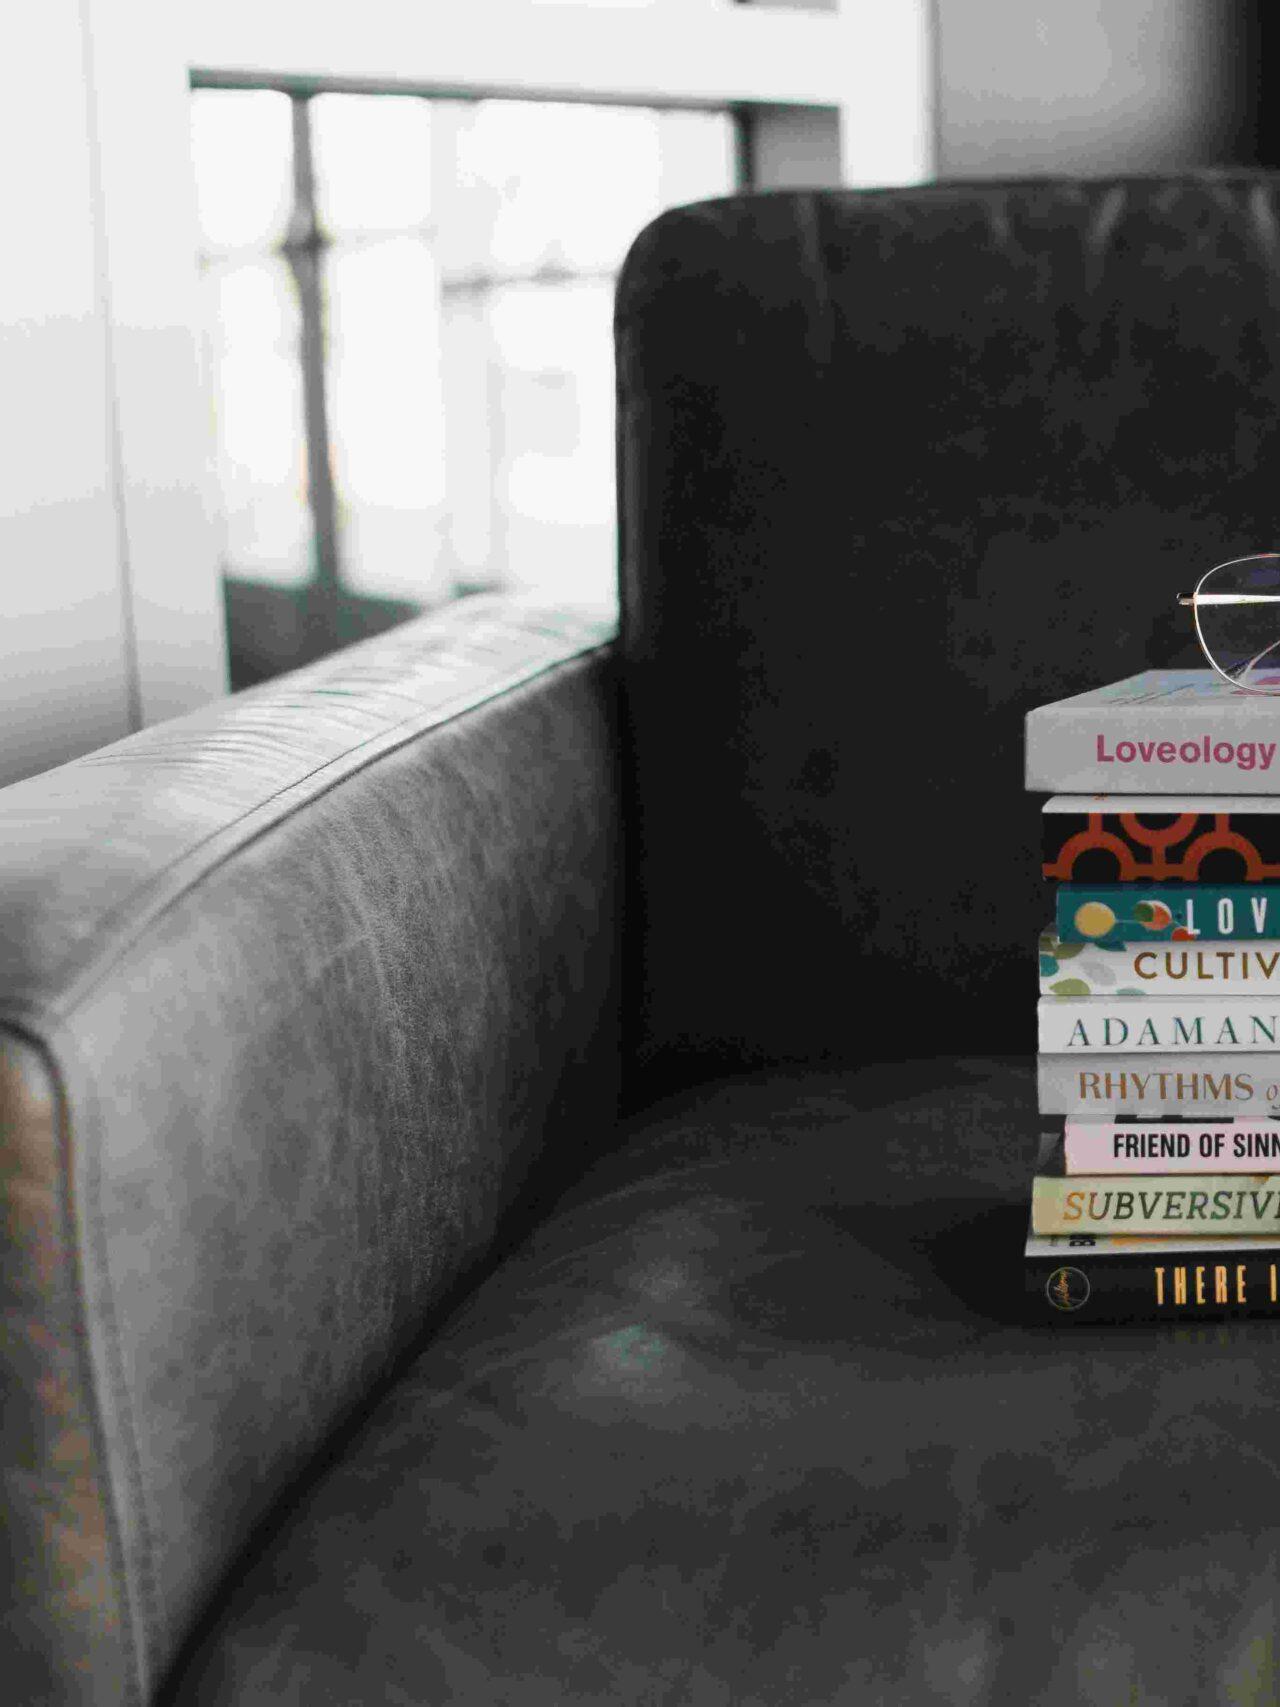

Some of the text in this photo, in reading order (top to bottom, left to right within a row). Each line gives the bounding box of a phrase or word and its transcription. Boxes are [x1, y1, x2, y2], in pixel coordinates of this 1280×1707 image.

[1097, 735, 1276, 770] Loveology
[1080, 1073, 1253, 1100] RHYTHMS
[1114, 1134, 1190, 1157] FRIEND
[1200, 1134, 1225, 1157] OF
[1155, 1265, 1246, 1304] THERE
